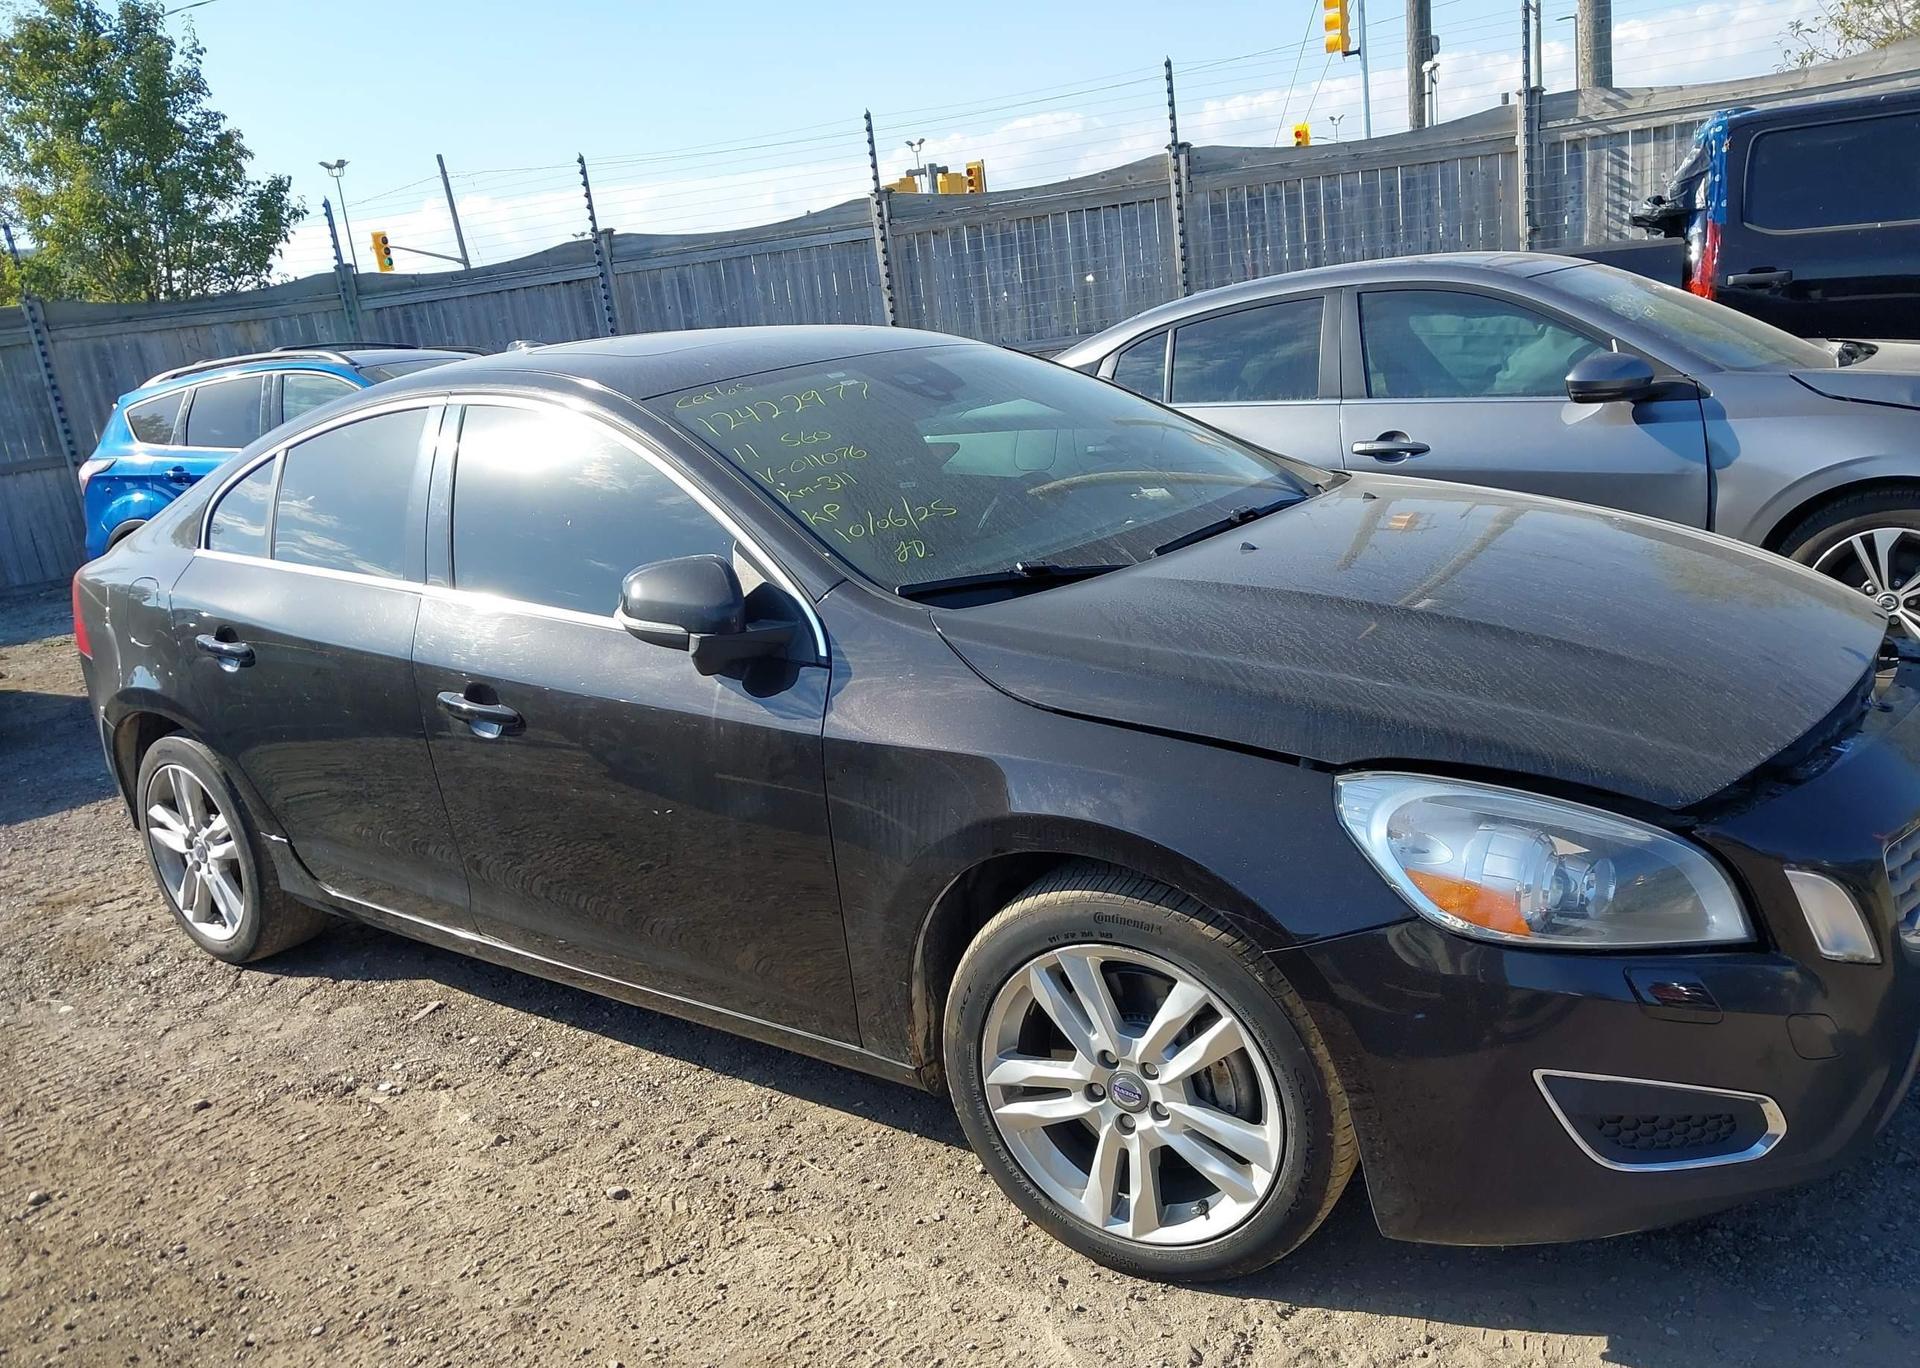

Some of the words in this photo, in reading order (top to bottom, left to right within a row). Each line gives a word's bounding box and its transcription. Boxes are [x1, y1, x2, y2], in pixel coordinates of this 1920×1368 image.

[696, 381, 869, 437] 12422977
[780, 430, 832, 448] S60
[755, 445, 868, 484] V-011076
[834, 496, 958, 544] 10/06/25
[1093, 911, 1155, 933] Continental
[1114, 1085, 1141, 1100] VOLVO
